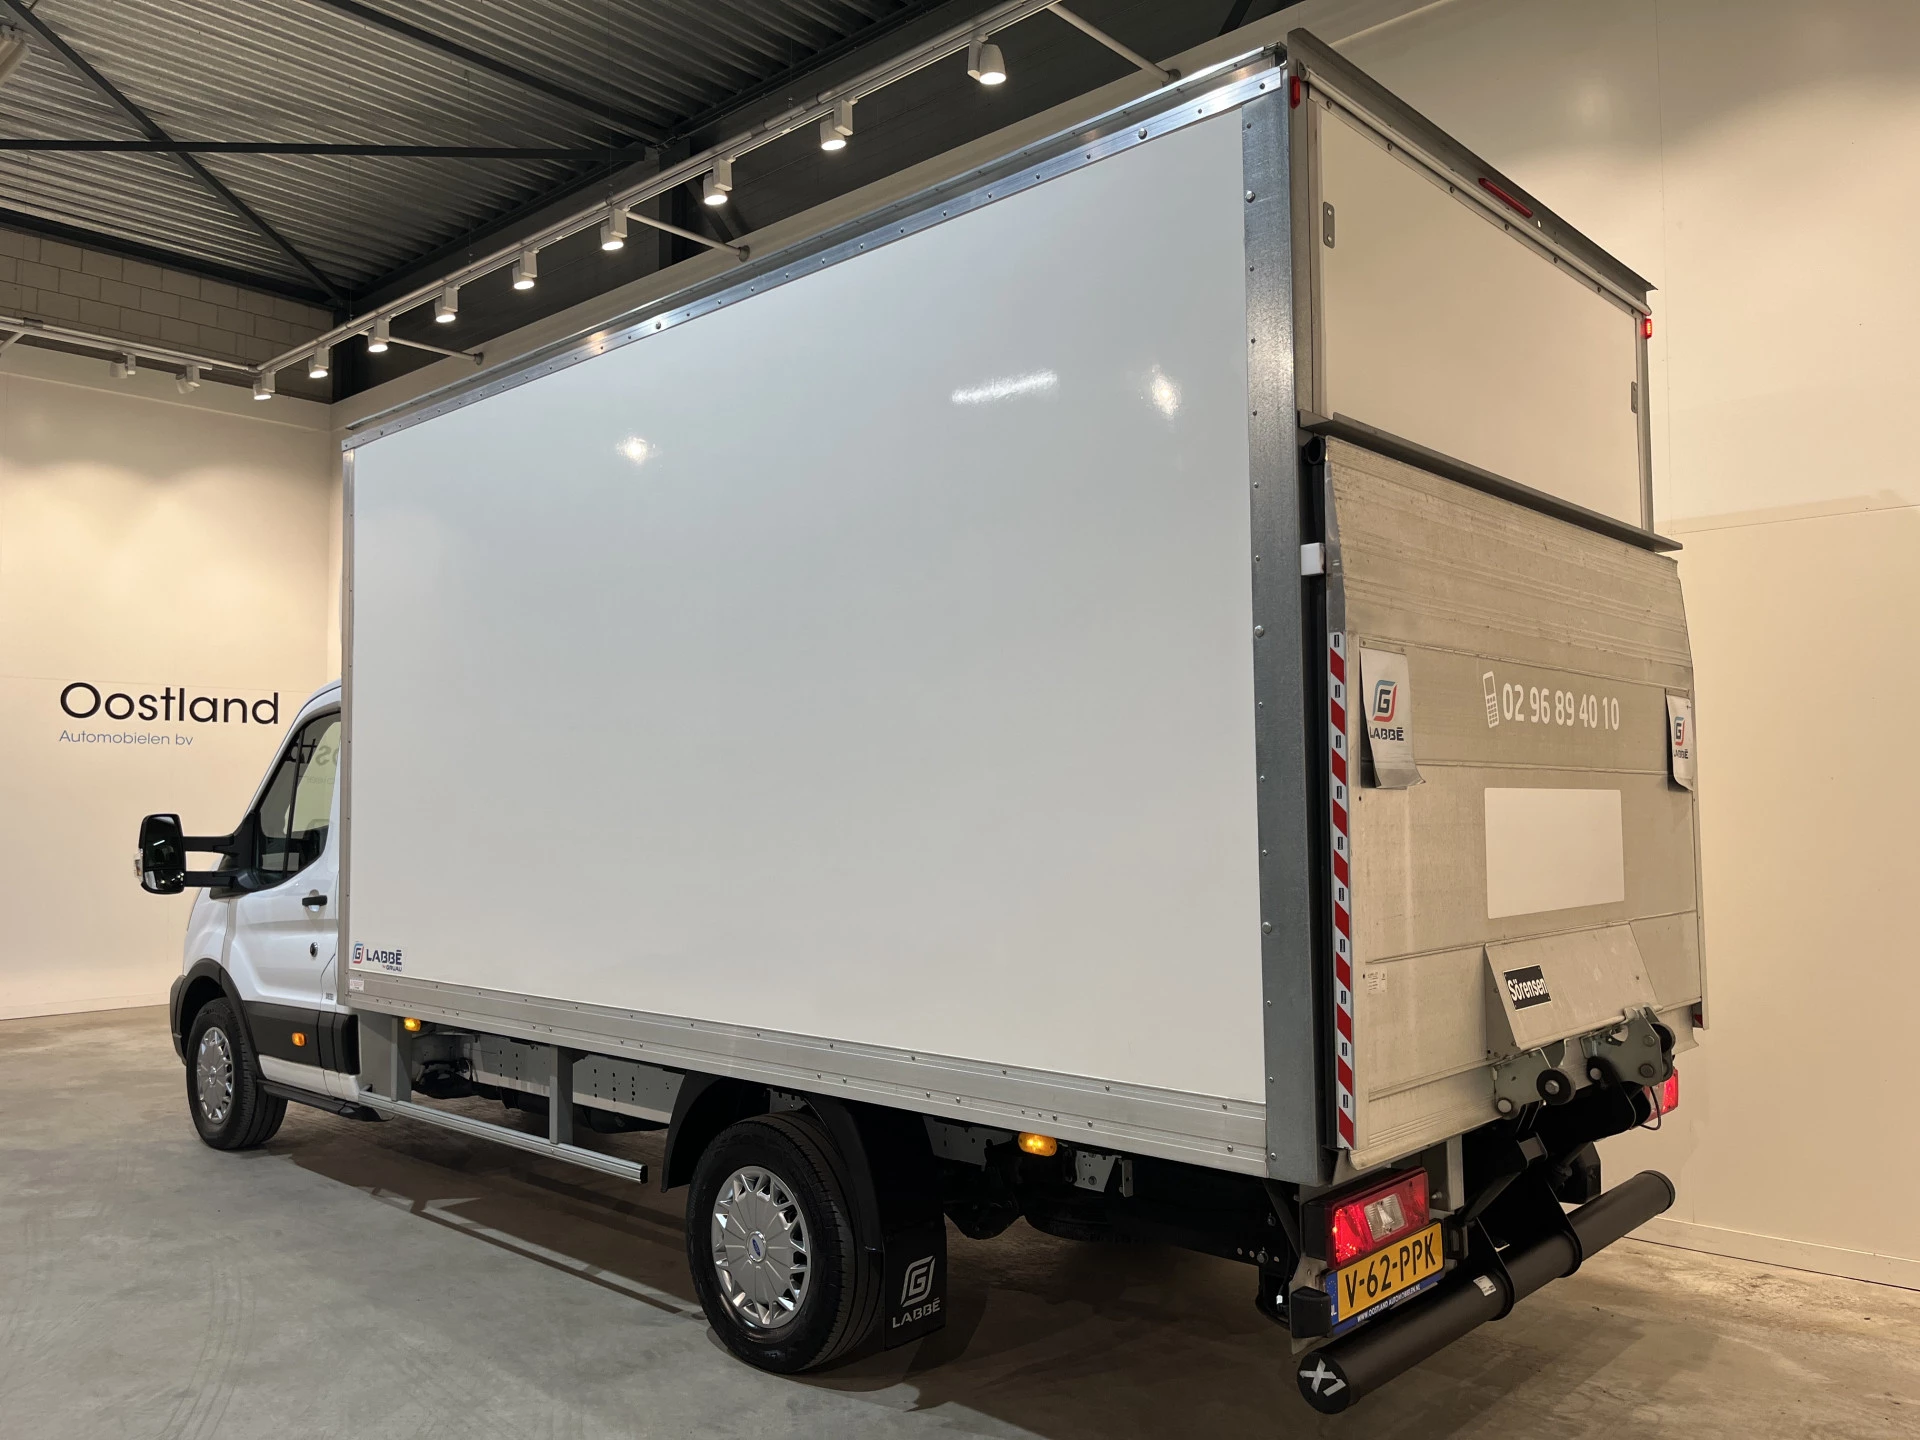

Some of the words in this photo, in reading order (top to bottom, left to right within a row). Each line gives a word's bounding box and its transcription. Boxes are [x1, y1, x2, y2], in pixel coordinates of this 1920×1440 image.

[60, 682, 279, 725] Oostland
[1503, 683, 1525, 722] 02
[1529, 686, 1551, 725] 96
[1555, 690, 1575, 727] 89
[1579, 694, 1598, 729] 40
[1602, 697, 1620, 731] 10
[59, 730, 170, 746] Automobielen
[175, 734, 194, 746] bv
[1507, 978, 1550, 1002] Sörensen
[1345, 1232, 1436, 1309] V-62-PPK
